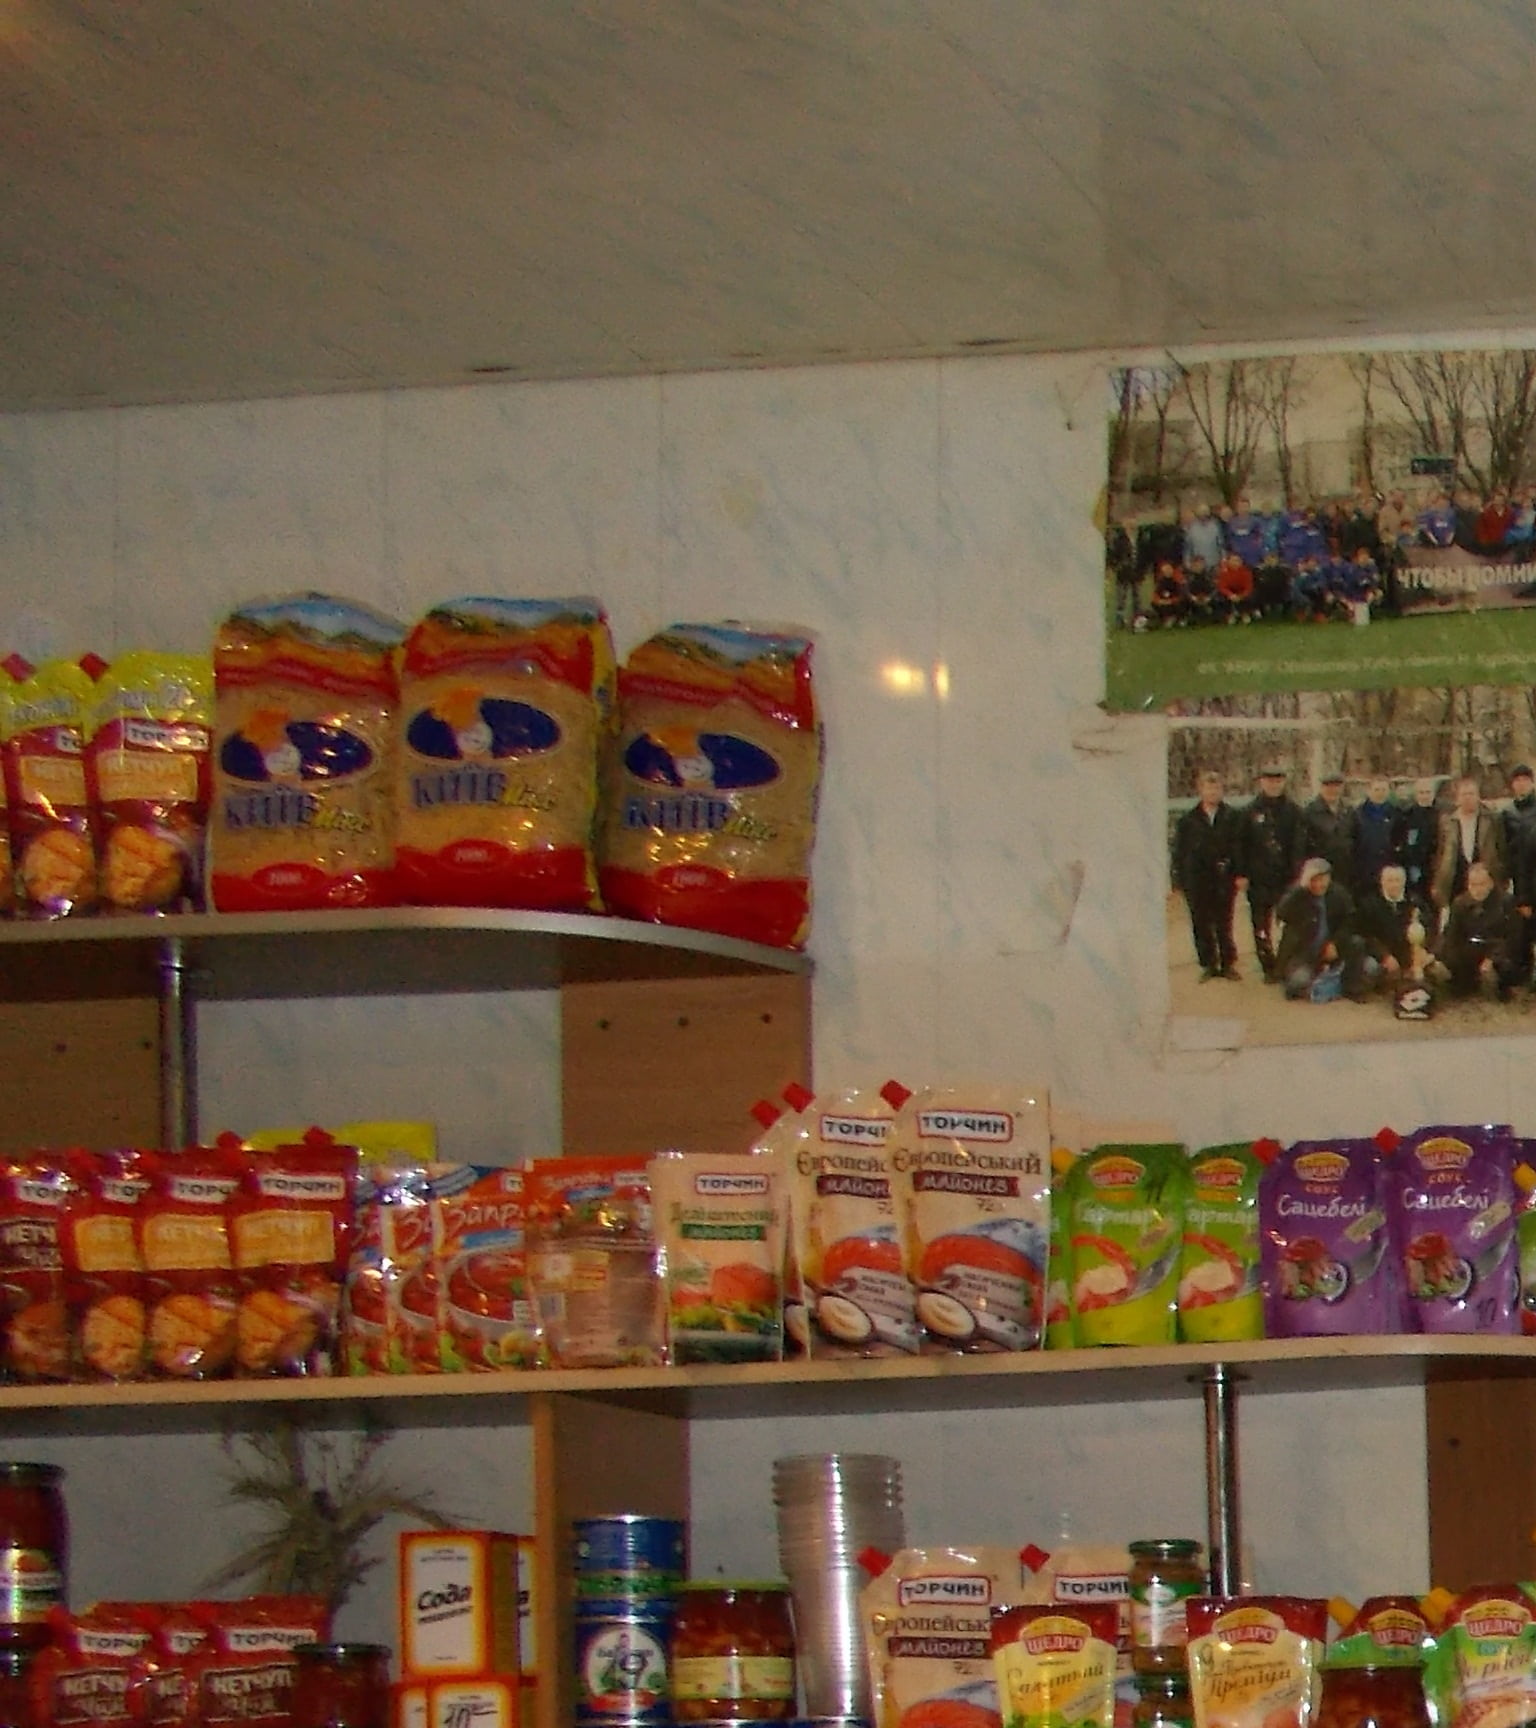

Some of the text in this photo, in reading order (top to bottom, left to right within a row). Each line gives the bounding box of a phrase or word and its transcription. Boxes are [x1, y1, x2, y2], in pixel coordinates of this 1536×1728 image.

[1396, 565, 1466, 588] ЧТОБЫ
[922, 1116, 1006, 1135] ТОРЧИН
[177, 1181, 235, 1196] ТОРЧ
[825, 1178, 889, 1194] МАЙОН
[417, 1582, 473, 1612] Сода
[904, 1583, 985, 1598] ТОРЧИН
[1026, 1635, 1085, 1652] ЩЕДРО
